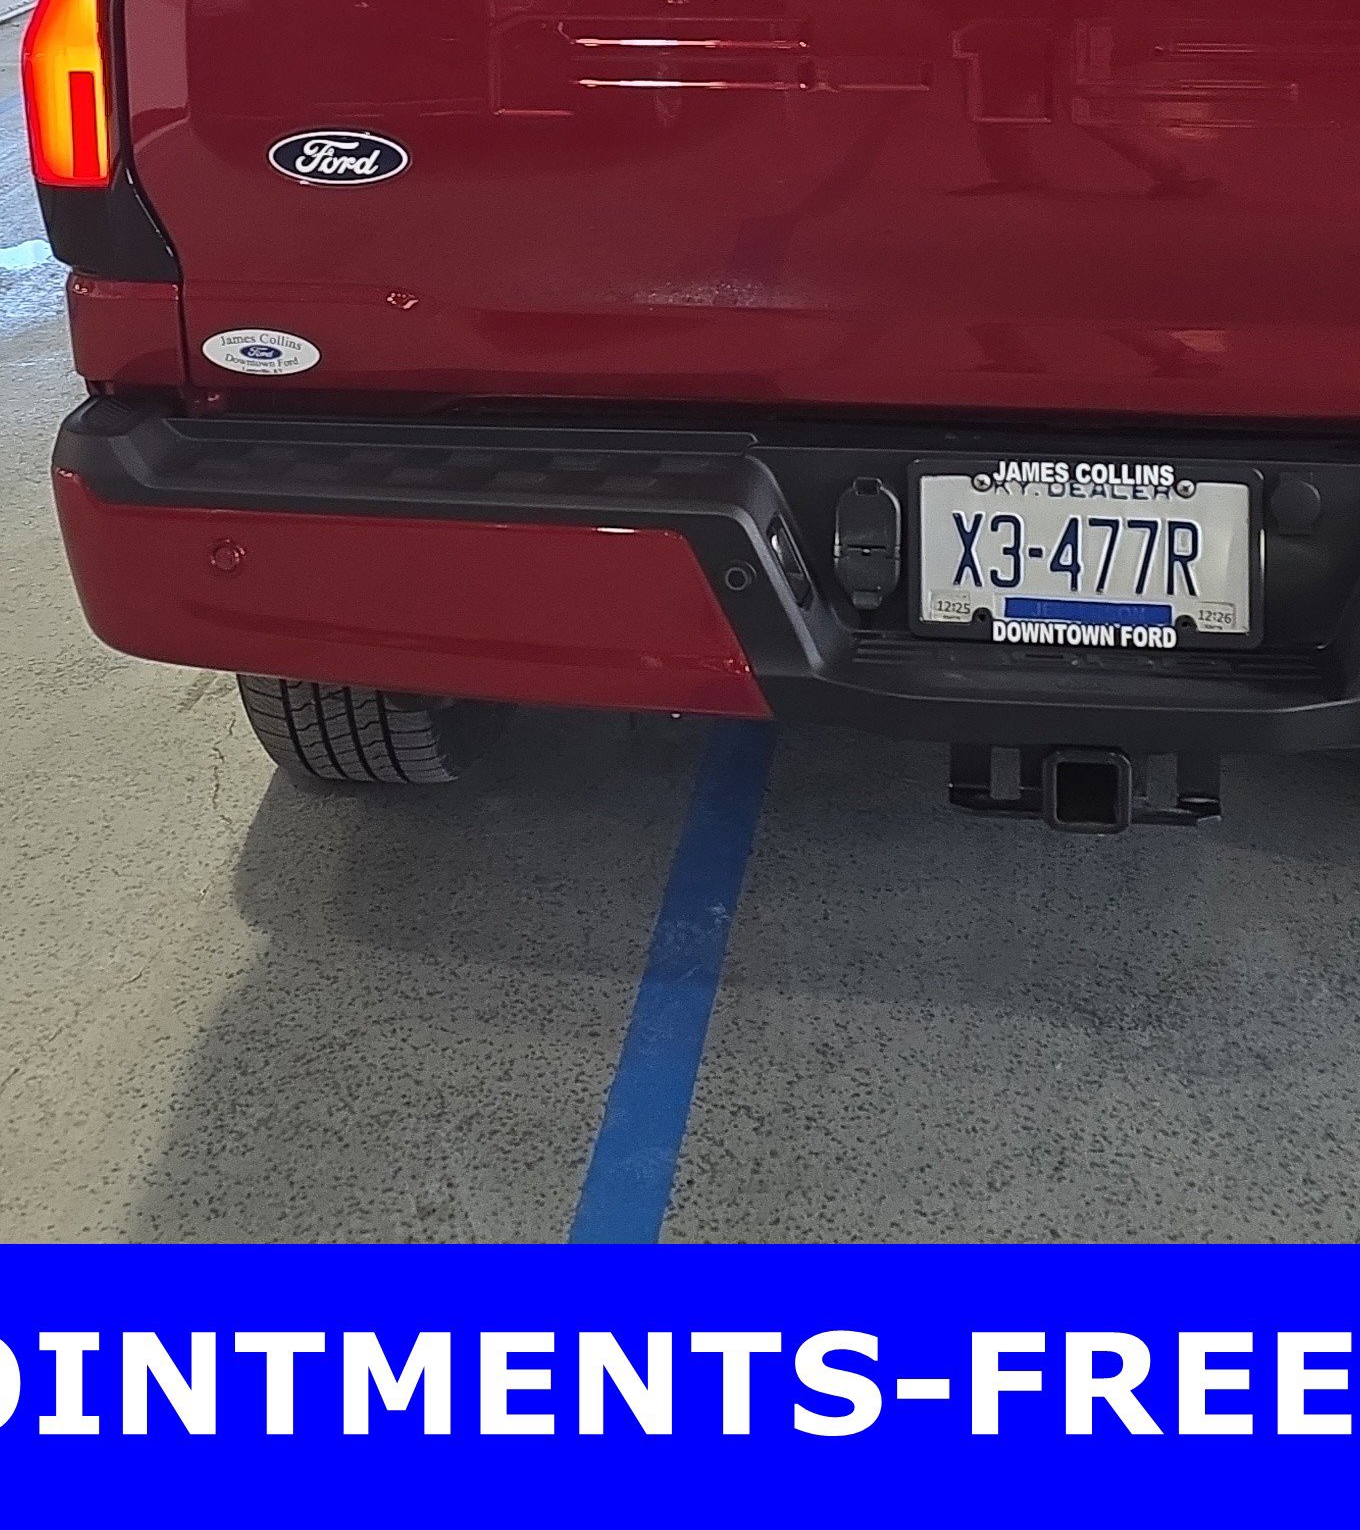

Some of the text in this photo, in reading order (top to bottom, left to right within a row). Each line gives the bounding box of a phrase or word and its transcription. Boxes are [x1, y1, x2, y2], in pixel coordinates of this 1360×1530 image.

[295, 139, 381, 175] Ford
[220, 333, 302, 351] James Collins
[225, 354, 299, 368] Downtown Ford
[992, 460, 1175, 486] JAMES COLLINS
[952, 512, 1199, 597] X3-477R
[992, 621, 1177, 648] DOWNTOWN FORD
